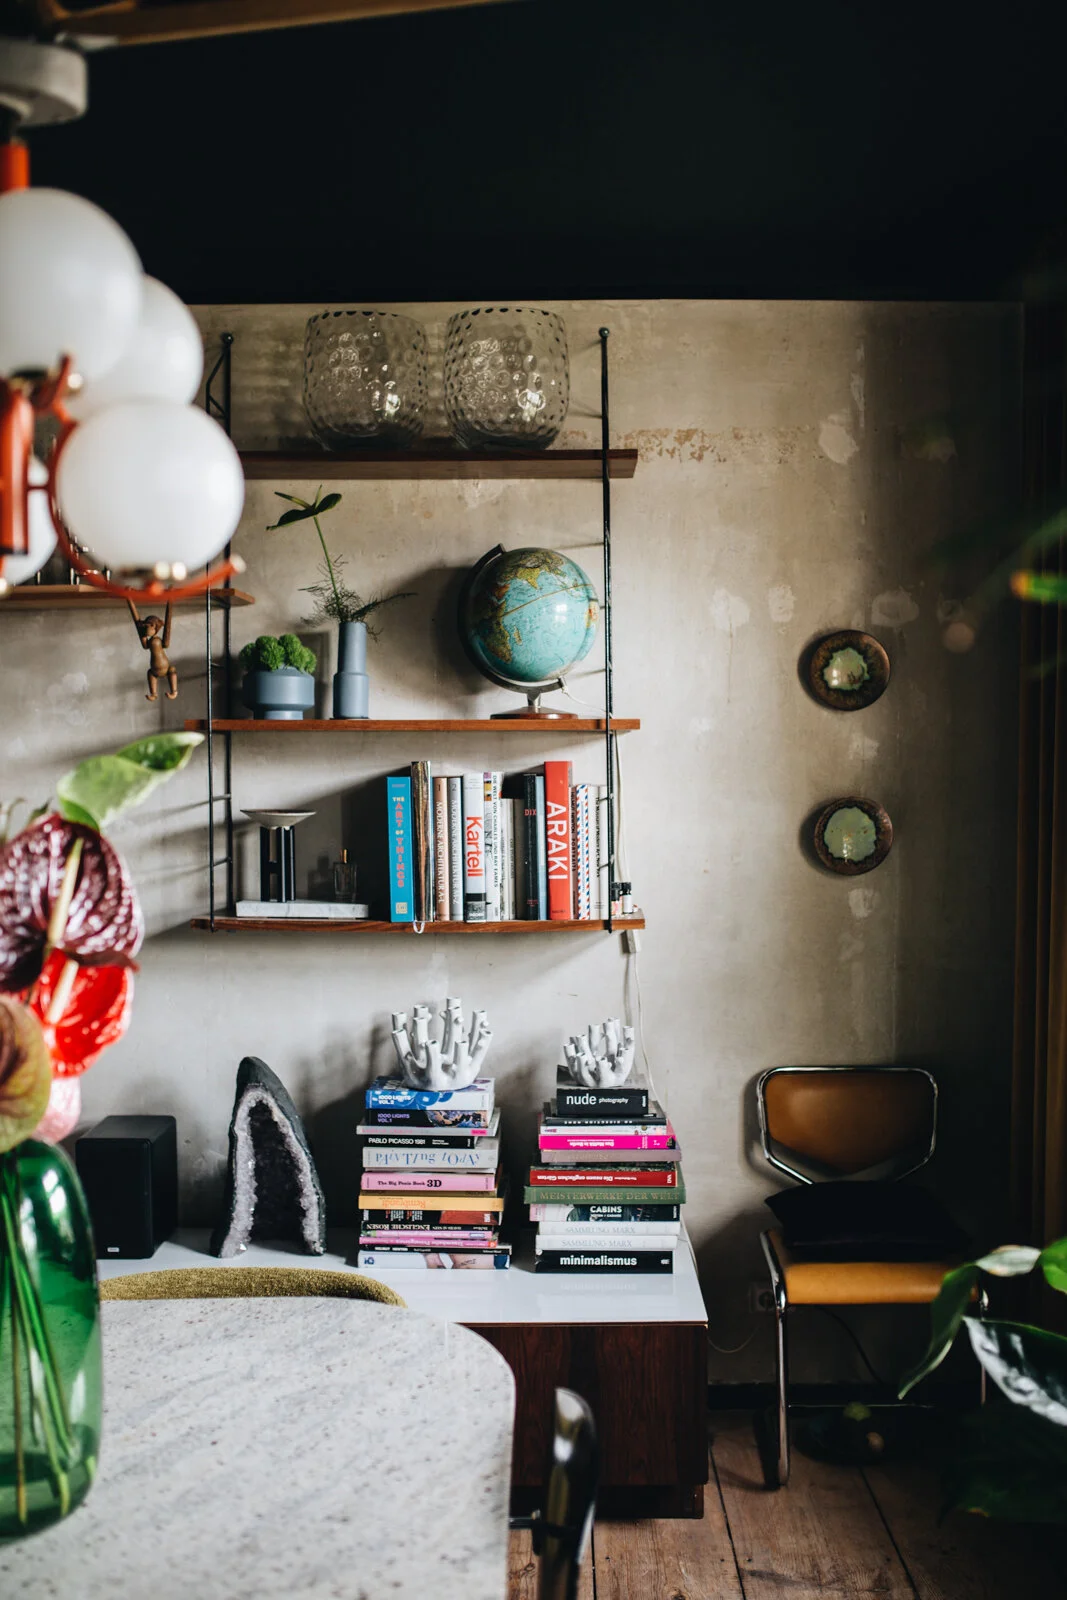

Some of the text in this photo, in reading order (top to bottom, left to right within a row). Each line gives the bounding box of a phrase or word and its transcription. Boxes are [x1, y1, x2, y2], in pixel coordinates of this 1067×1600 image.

[395, 803, 404, 827] ART
[524, 808, 537, 816] DIX
[466, 816, 484, 877] Kartell
[546, 802, 568, 880] ARAKI
[396, 837, 405, 888] THINGS
[566, 1093, 596, 1105] nude
[426, 1180, 442, 1188] 3D
[540, 1192, 624, 1200] MEISTERWERKE
[590, 1206, 622, 1214] CABINS
[560, 1255, 638, 1266] minimalismus
